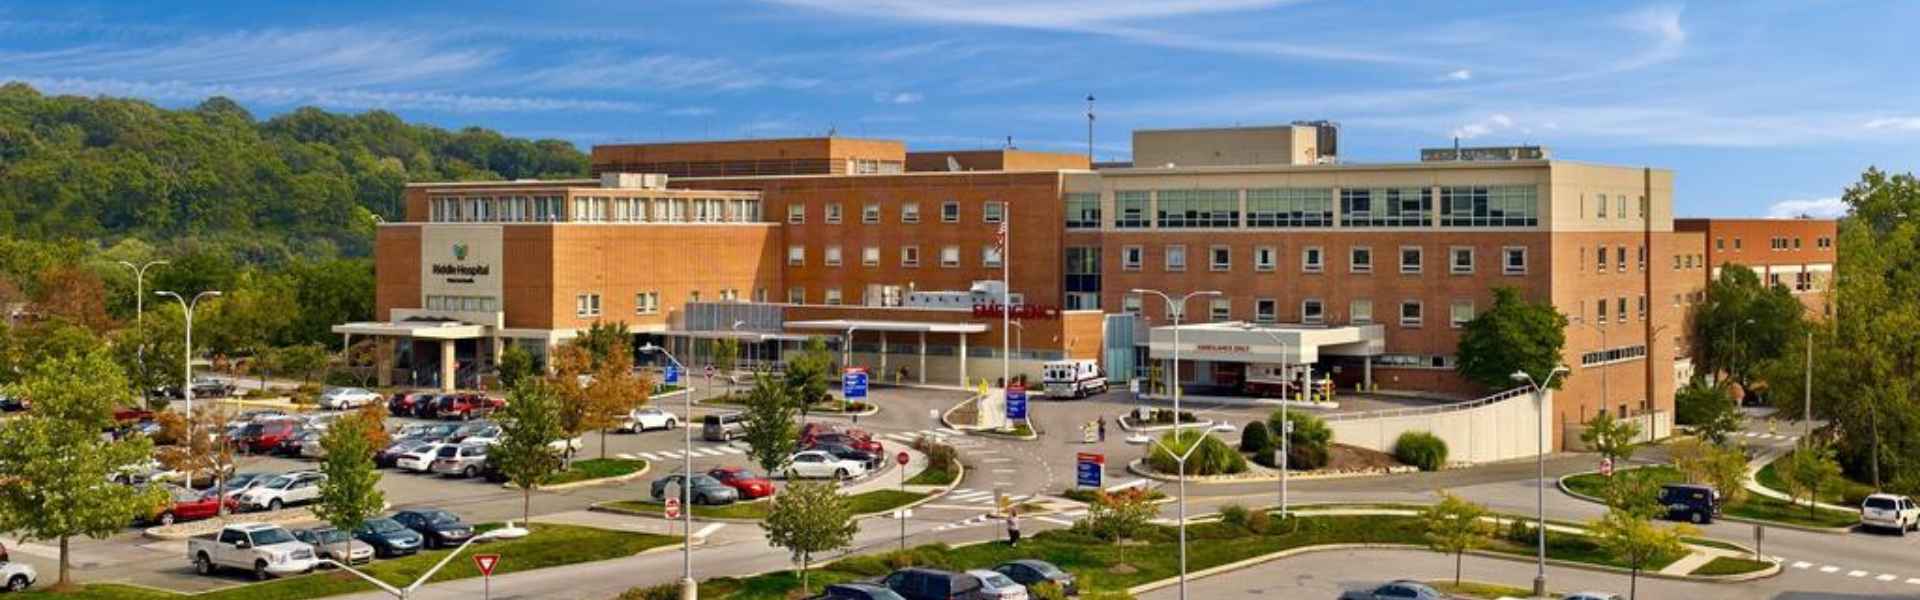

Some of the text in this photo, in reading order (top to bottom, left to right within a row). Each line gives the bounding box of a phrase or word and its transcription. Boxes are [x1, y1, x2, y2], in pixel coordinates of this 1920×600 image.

[432, 264, 489, 276] Riddle Hospital
[972, 303, 1062, 319] EMERGENCY
